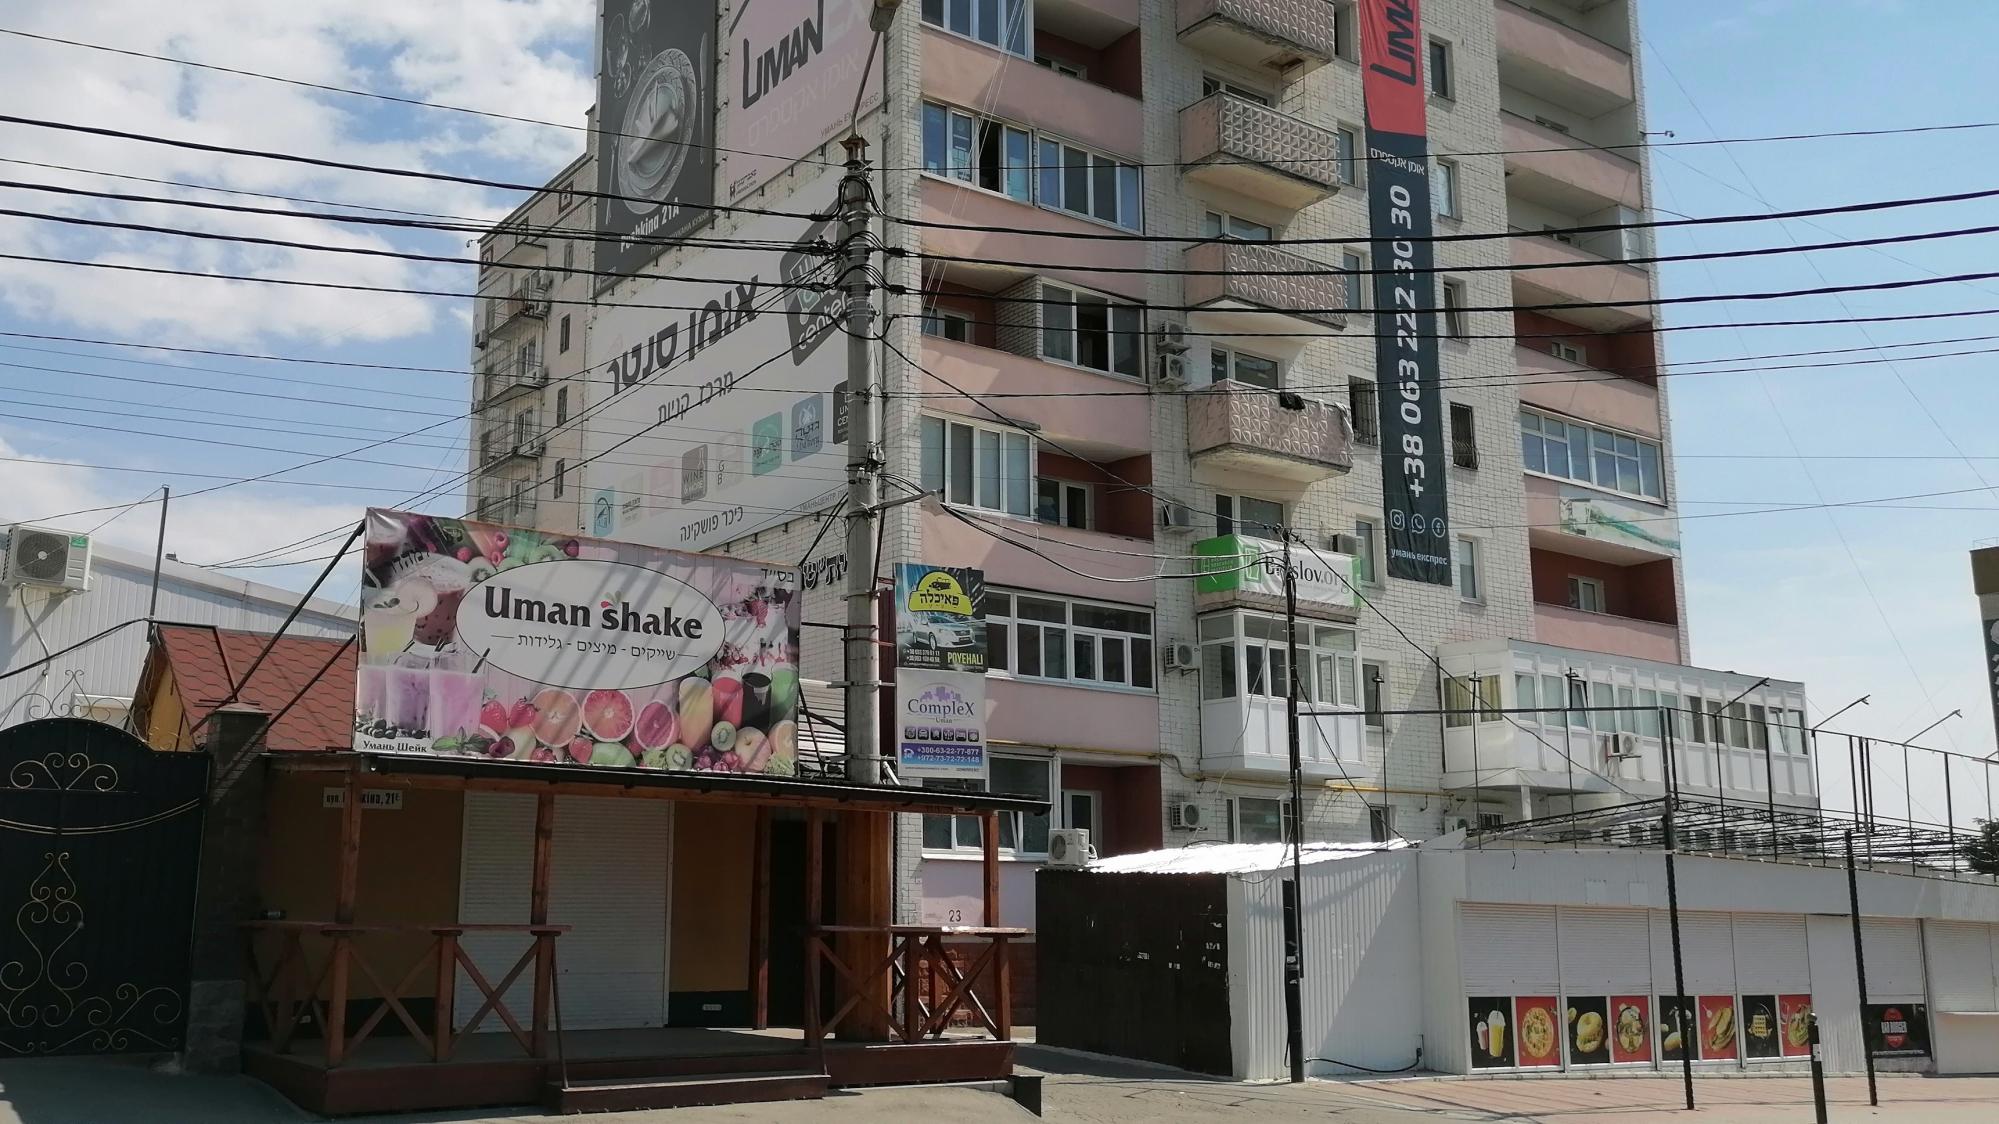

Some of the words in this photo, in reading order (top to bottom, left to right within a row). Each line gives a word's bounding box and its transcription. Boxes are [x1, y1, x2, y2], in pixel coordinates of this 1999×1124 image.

[1389, 185, 1412, 230] 30
[1392, 235, 1414, 281] 30
[689, 274, 759, 362] אומן
[1394, 286, 1418, 352] 222
[606, 321, 678, 395] סנטר
[699, 371, 734, 406] מרכז
[1398, 358, 1422, 425] 063
[658, 393, 690, 427] קניות
[682, 470, 704, 484] WINE
[1403, 434, 1425, 498] +38
[680, 515, 719, 542] פושקינה
[721, 507, 744, 527] כיכר
[1390, 548, 1416, 560] умань
[920, 589, 960, 607] פאיכלה
[485, 585, 591, 628] Uman
[601, 601, 703, 640] shake
[517, 634, 563, 650] גלידות
[577, 640, 617, 655] מיצים
[631, 647, 676, 662] שייקים
[908, 698, 975, 718] CompleX
[363, 740, 395, 751] Умань
[397, 742, 427, 753] Шейк
[948, 909, 962, 923] 23
